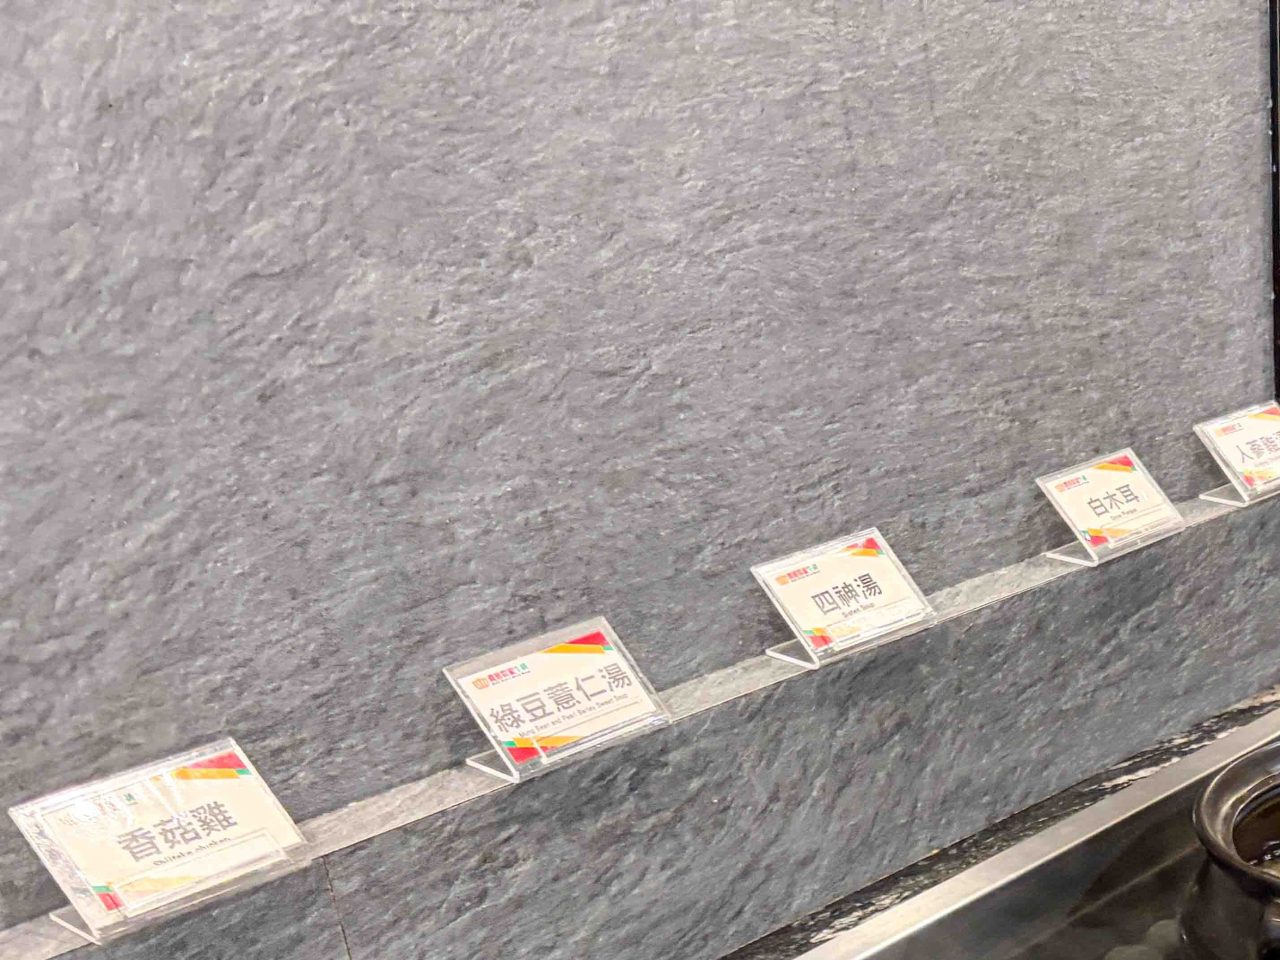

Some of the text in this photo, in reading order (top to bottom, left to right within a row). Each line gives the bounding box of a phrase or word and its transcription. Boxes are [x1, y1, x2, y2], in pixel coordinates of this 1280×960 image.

[1087, 484, 1140, 517] 白木耳
[811, 573, 882, 615] 四神湯
[489, 662, 632, 733] 綠豆薏仁湯
[117, 801, 237, 862] 香菇雞
